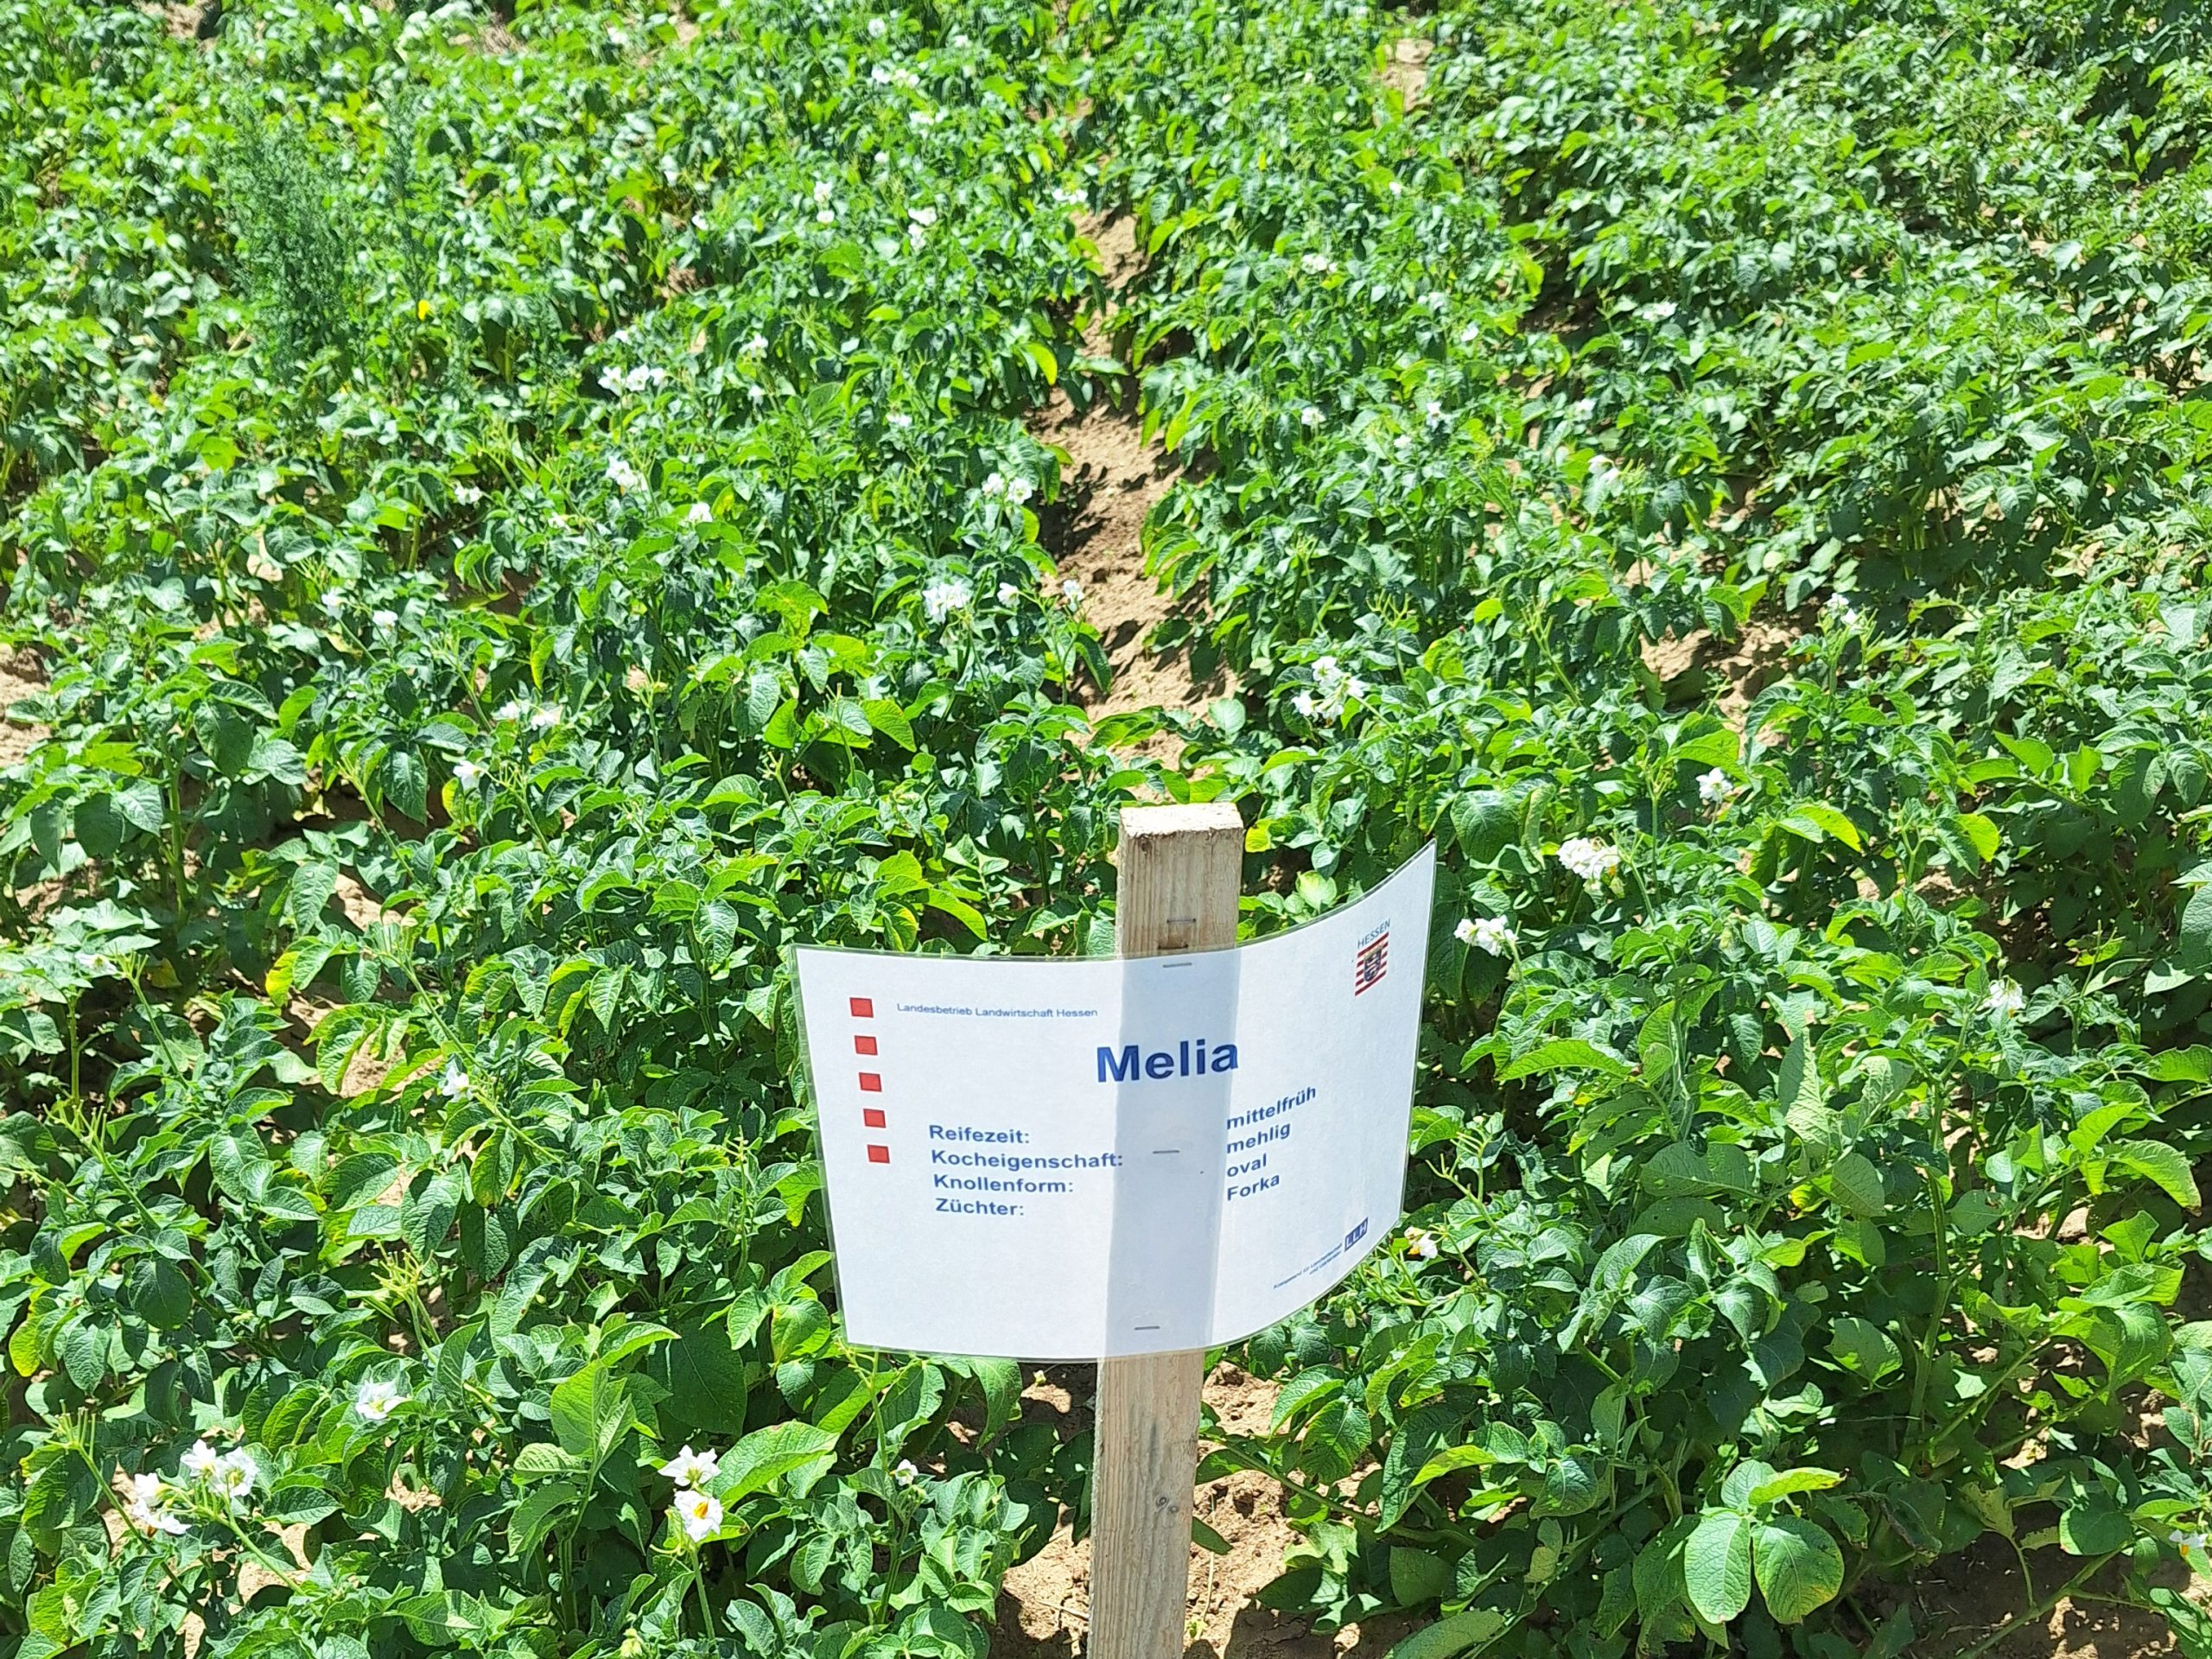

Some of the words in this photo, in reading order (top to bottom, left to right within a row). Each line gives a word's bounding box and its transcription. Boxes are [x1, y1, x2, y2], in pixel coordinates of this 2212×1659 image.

[1357, 918, 1390, 949] HESSEN
[897, 1002, 972, 1016] Landesbetrieb
[976, 1007, 1053, 1018] Landwirtschaft
[1057, 1008, 1098, 1018] Hessen
[1096, 1039, 1238, 1083] Melia
[1227, 1087, 1316, 1130] mittelfrüh
[929, 1124, 1030, 1144] Reifezeit:
[1227, 1123, 1291, 1154] mehlig
[931, 1149, 1123, 1172] Kocheigenschaft:
[1227, 1153, 1267, 1177] oval
[934, 1173, 1073, 1192] Knollenform:
[1227, 1175, 1280, 1201] Forka
[935, 1198, 1024, 1216] Züchter:
[1345, 1219, 1367, 1249] LLH
